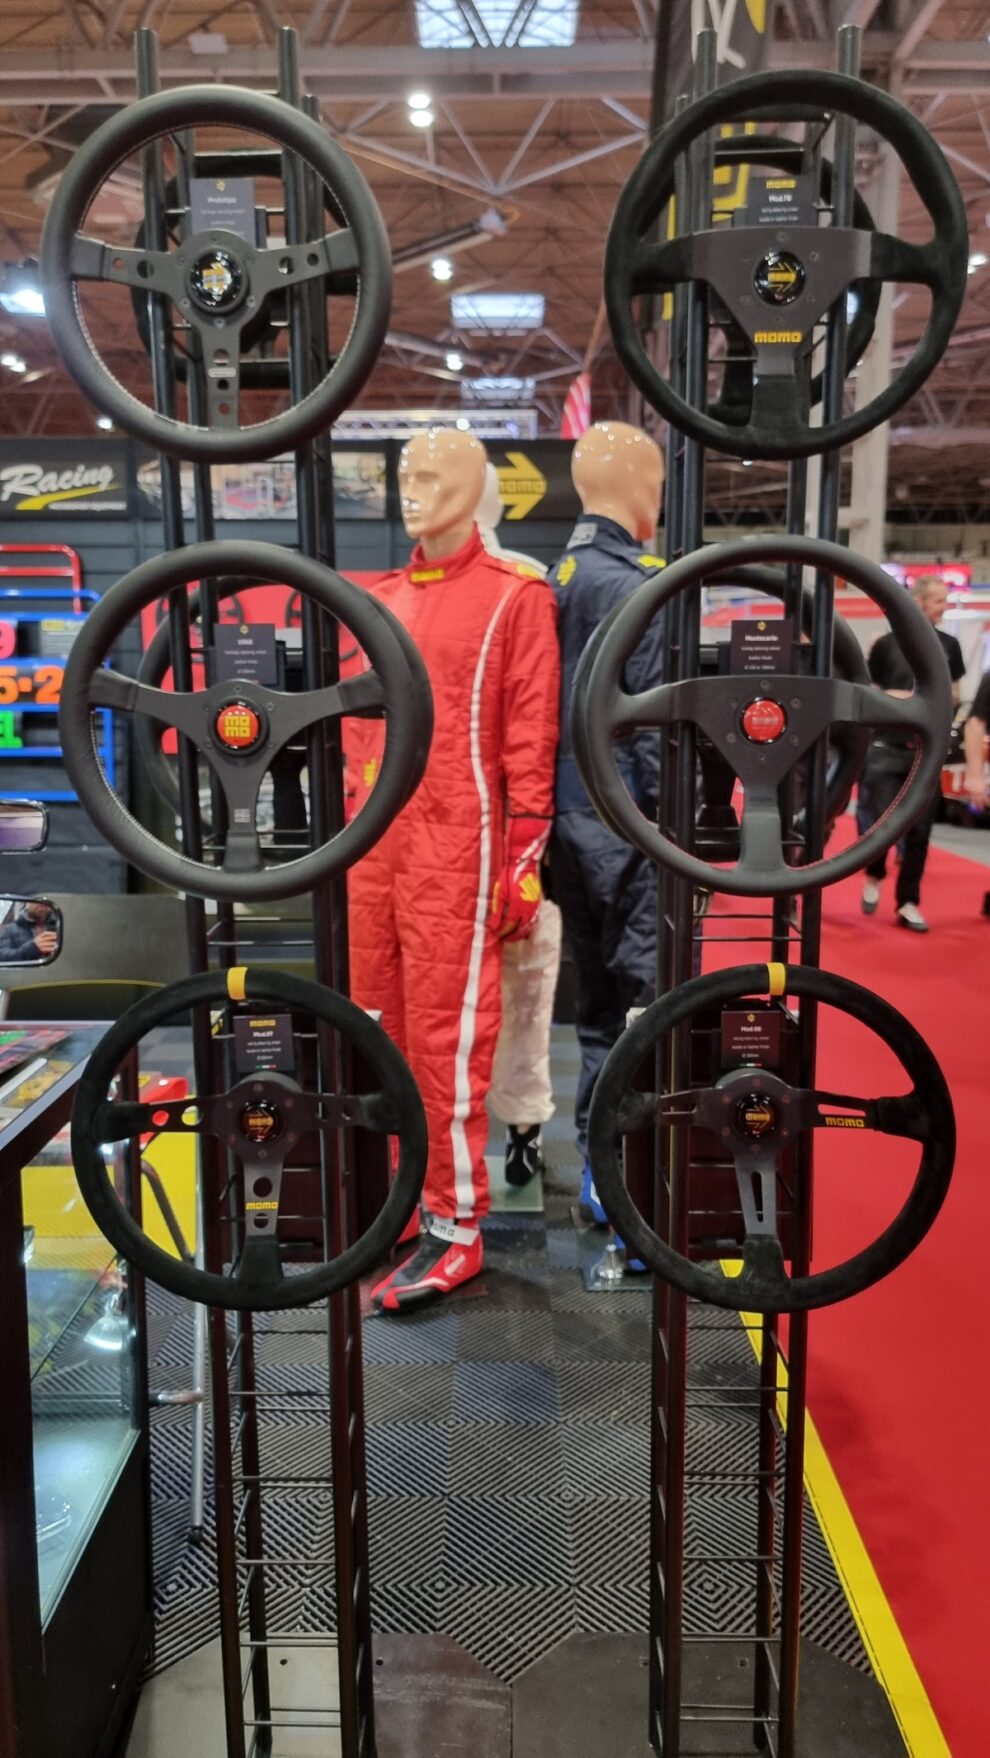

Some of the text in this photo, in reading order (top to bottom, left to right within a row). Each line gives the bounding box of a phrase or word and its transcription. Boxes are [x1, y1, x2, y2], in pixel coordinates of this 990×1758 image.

[754, 332, 803, 343] momo
[0, 464, 115, 502] Racing
[824, 1117, 866, 1128] momo
[245, 1202, 279, 1210] momo
